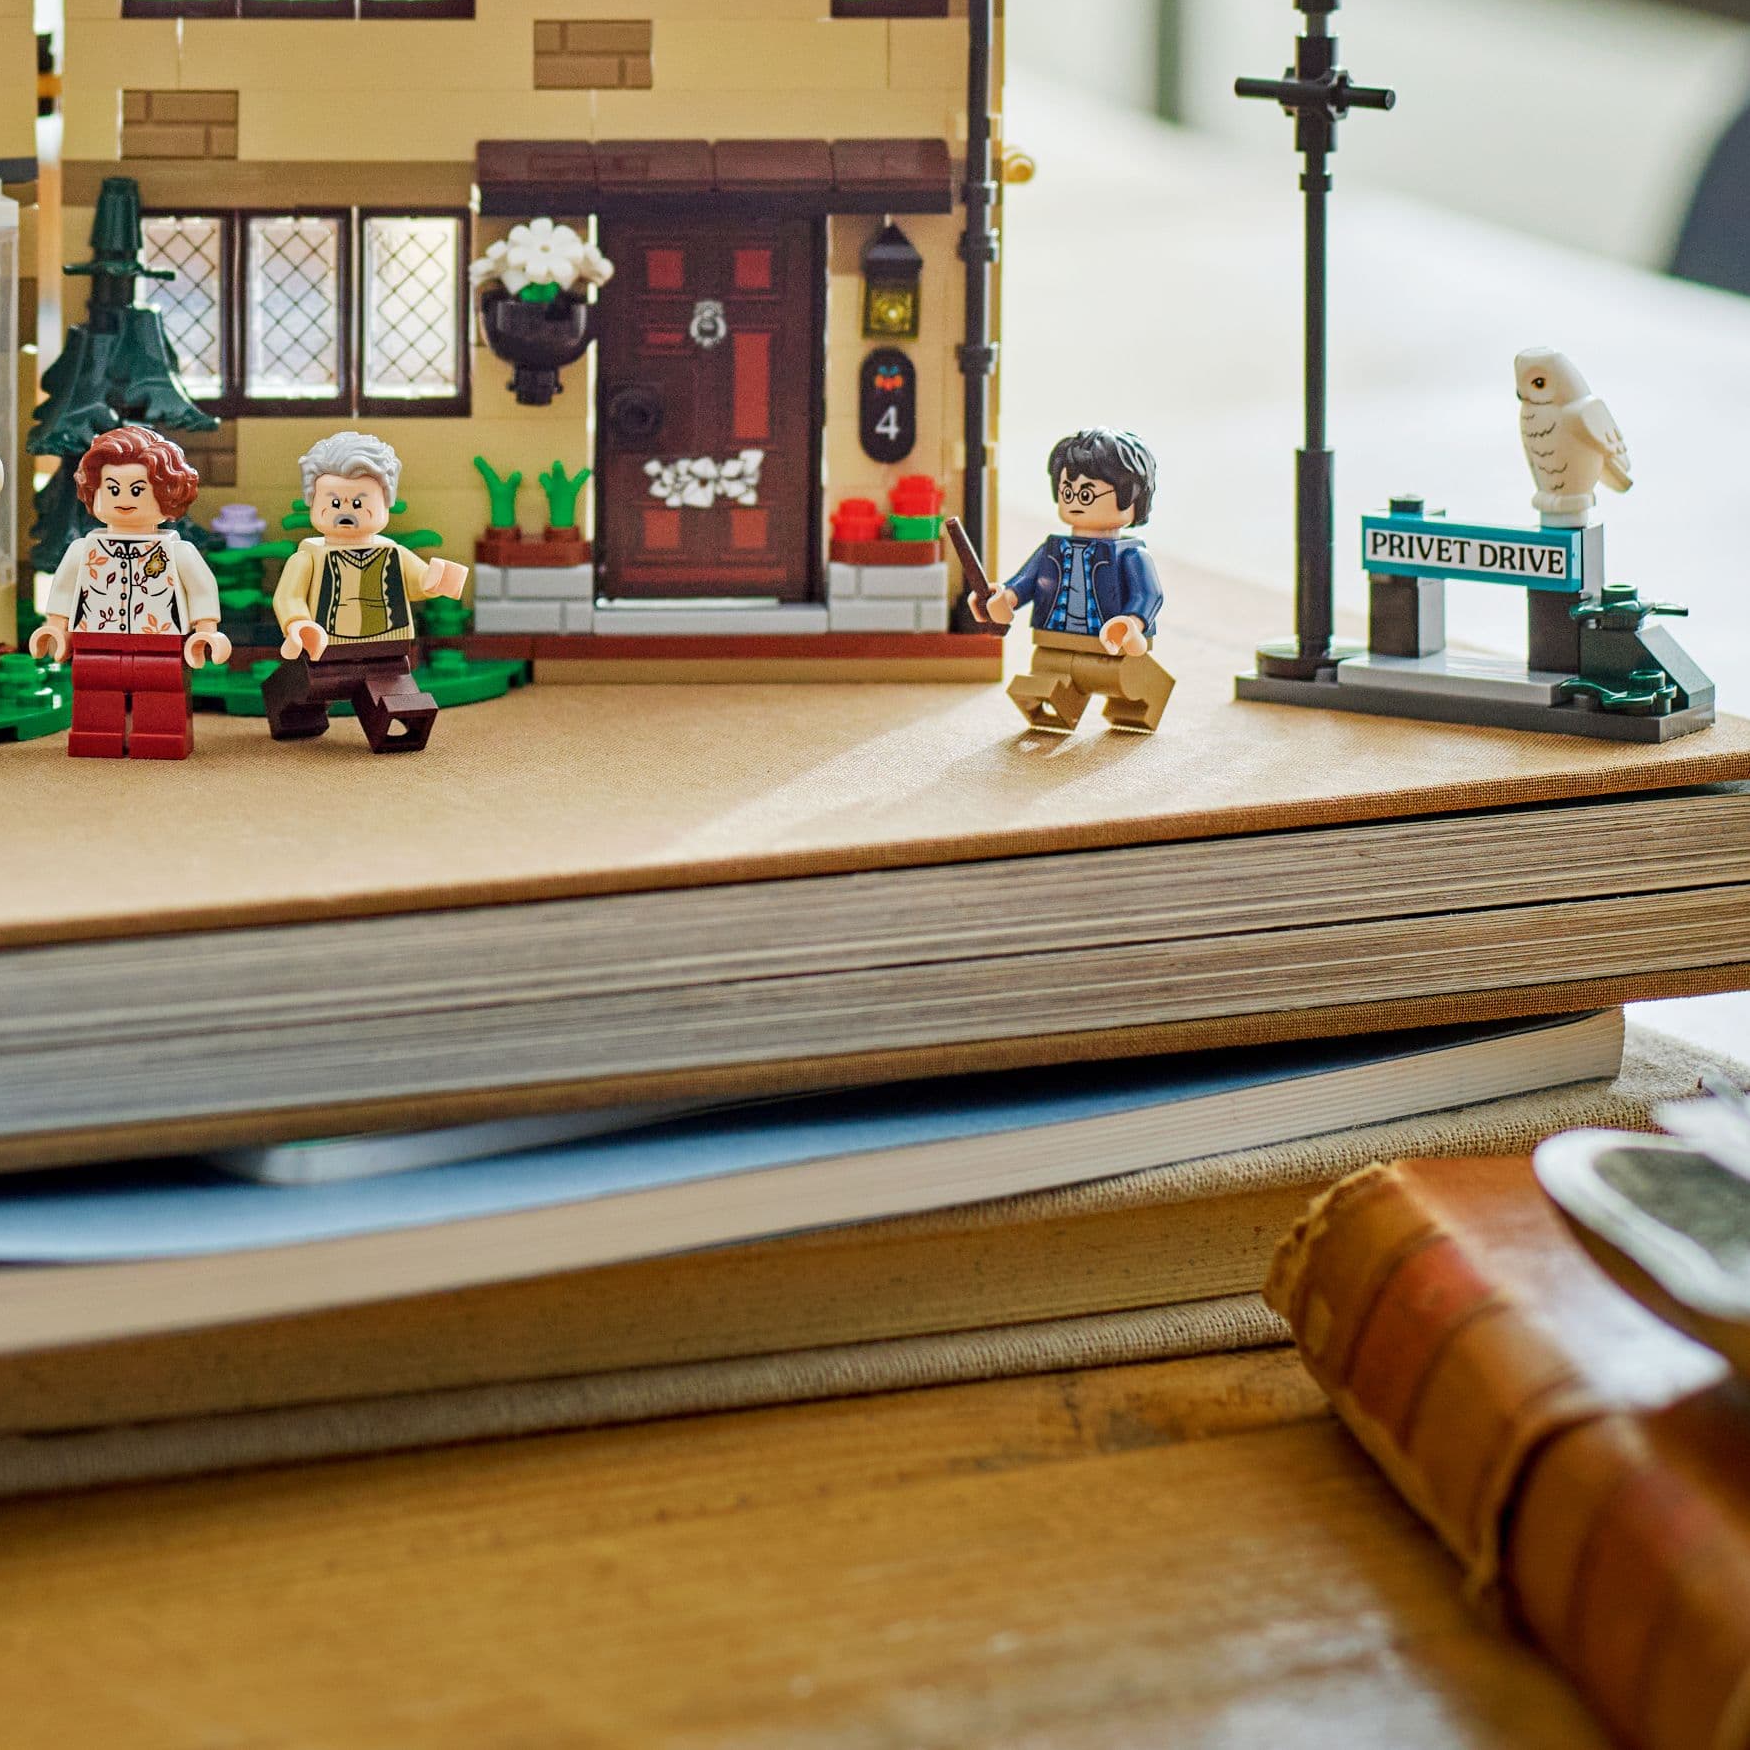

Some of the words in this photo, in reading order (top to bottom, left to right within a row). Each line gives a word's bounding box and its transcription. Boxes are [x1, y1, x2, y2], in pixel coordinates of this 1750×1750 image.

[875, 405, 900, 440] 4
[1371, 531, 1471, 565] PRIVET
[1478, 543, 1564, 575] DRIVE
